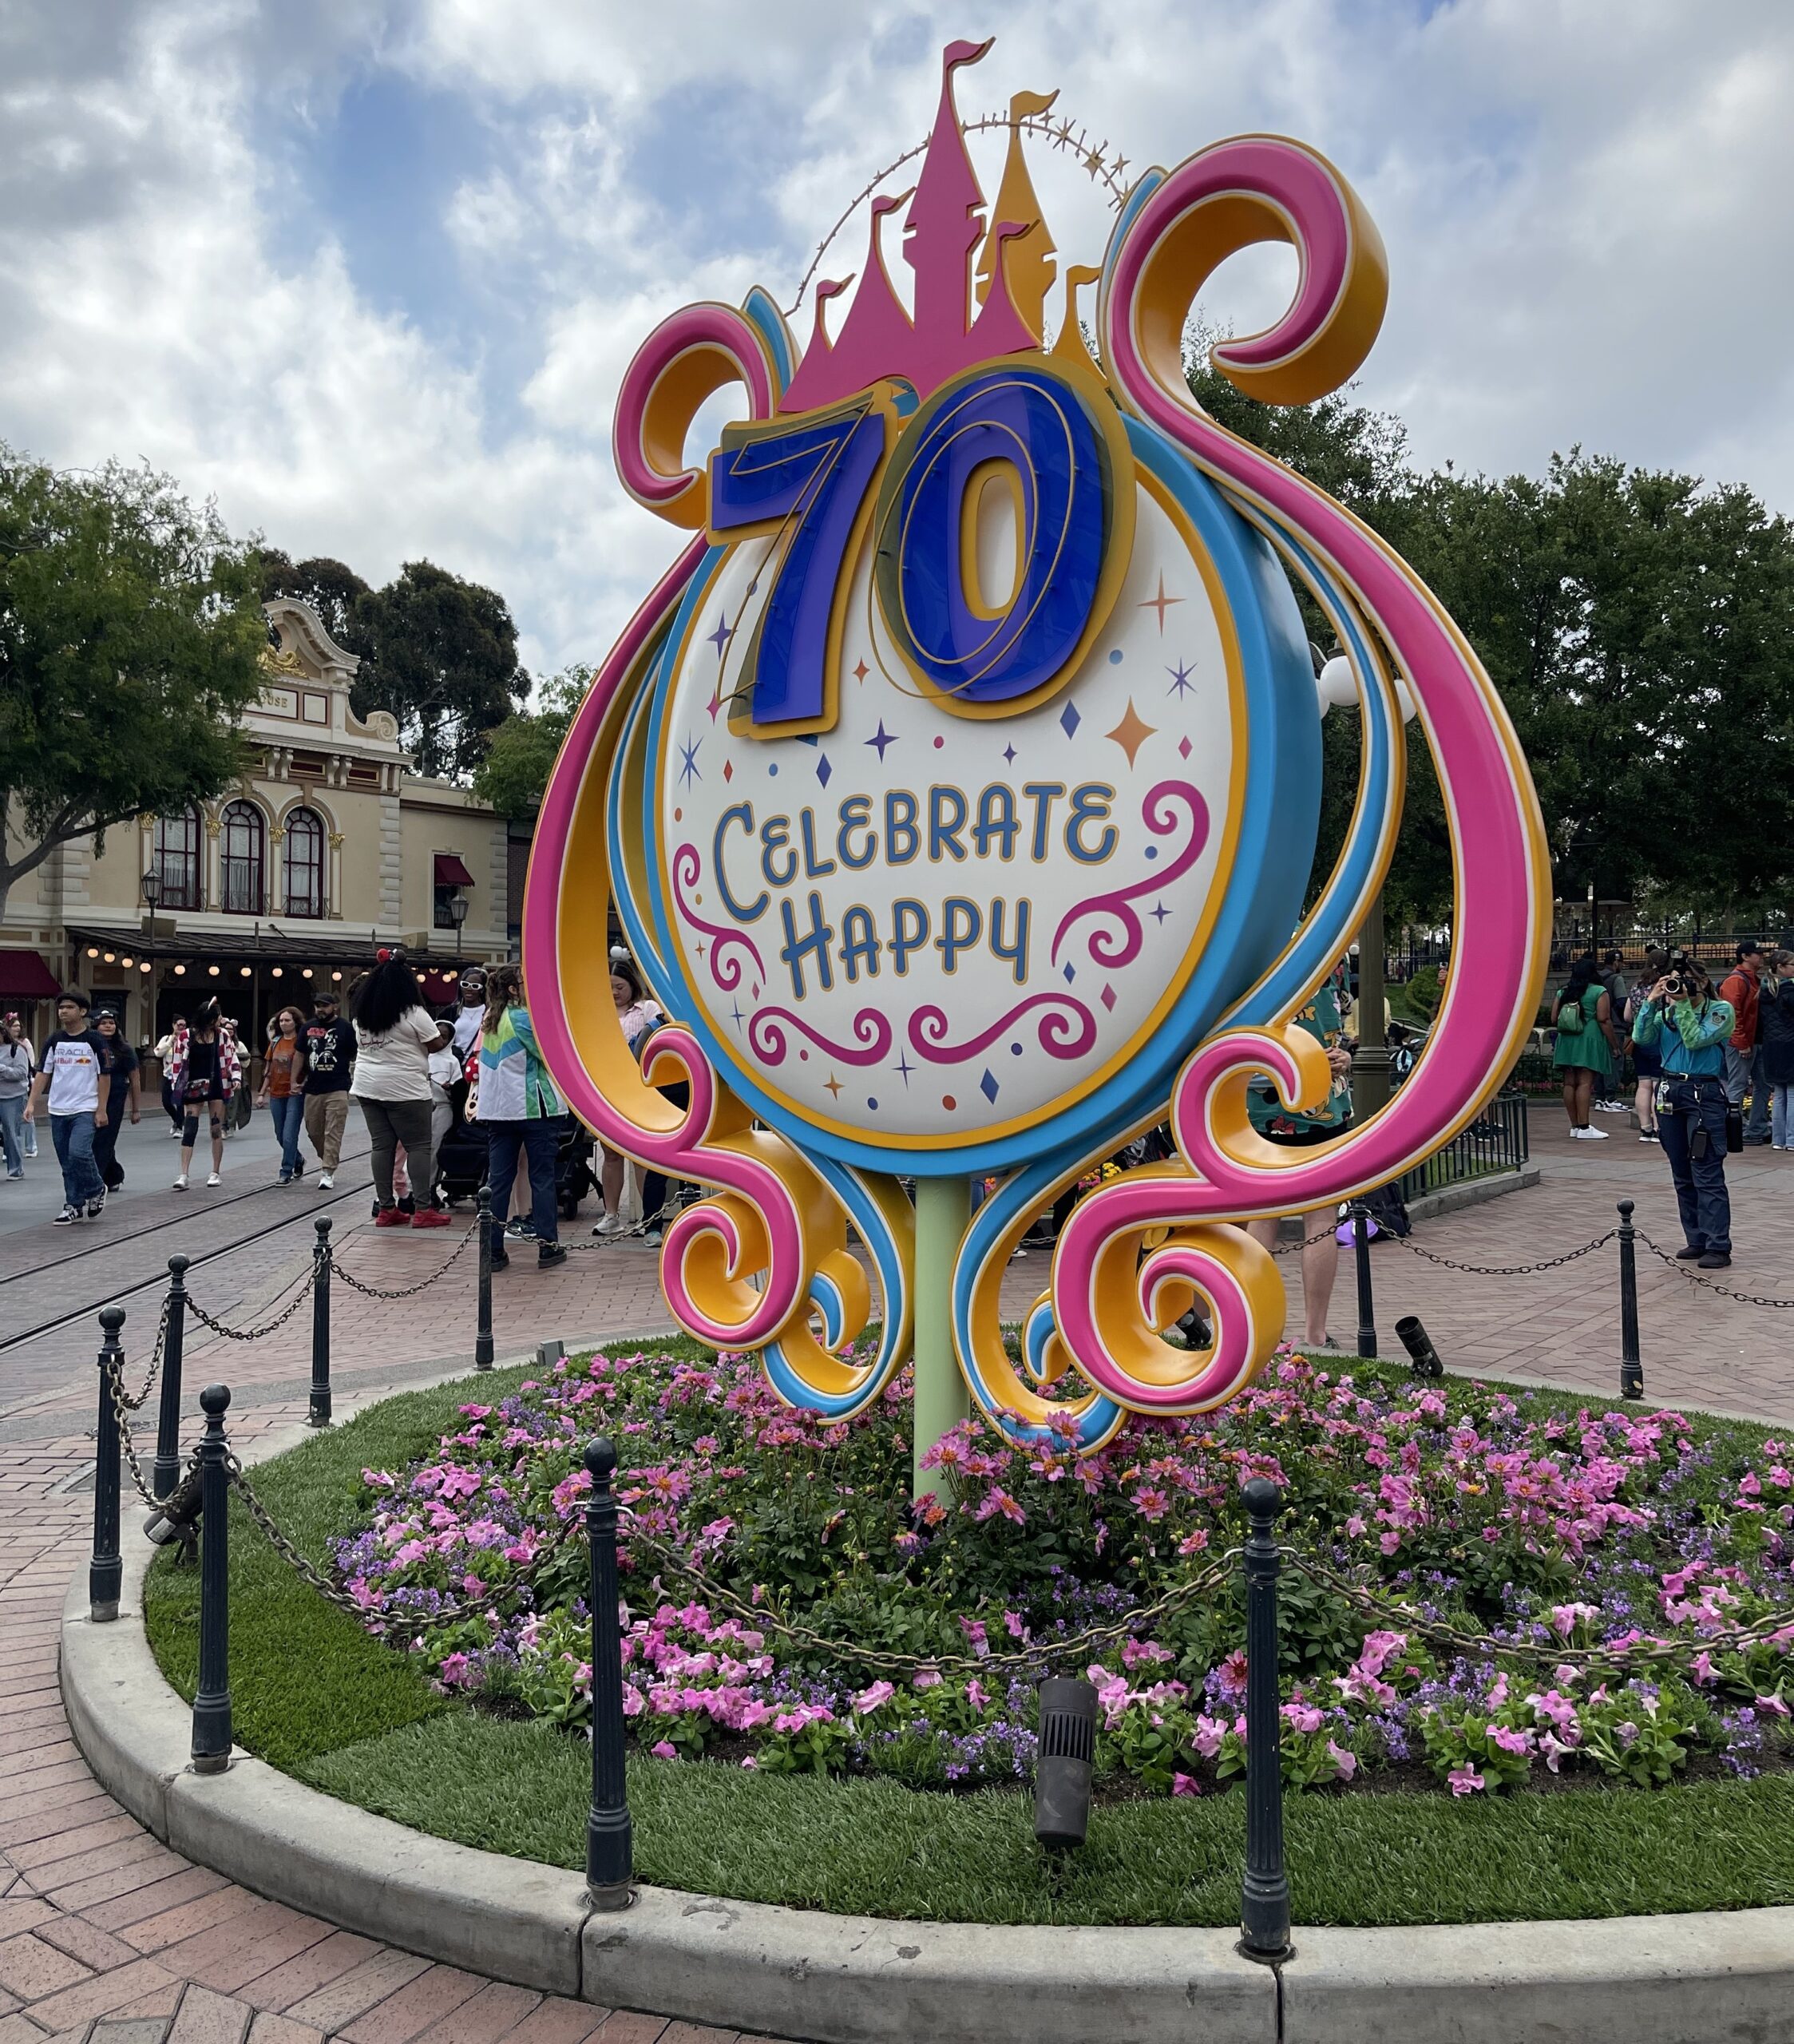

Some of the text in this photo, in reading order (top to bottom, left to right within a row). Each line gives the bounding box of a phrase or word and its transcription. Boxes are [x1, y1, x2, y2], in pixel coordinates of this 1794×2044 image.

[707, 353, 1137, 739] 70
[713, 782, 1119, 925] CELEBRATE
[779, 890, 1032, 1001] HAPPY
